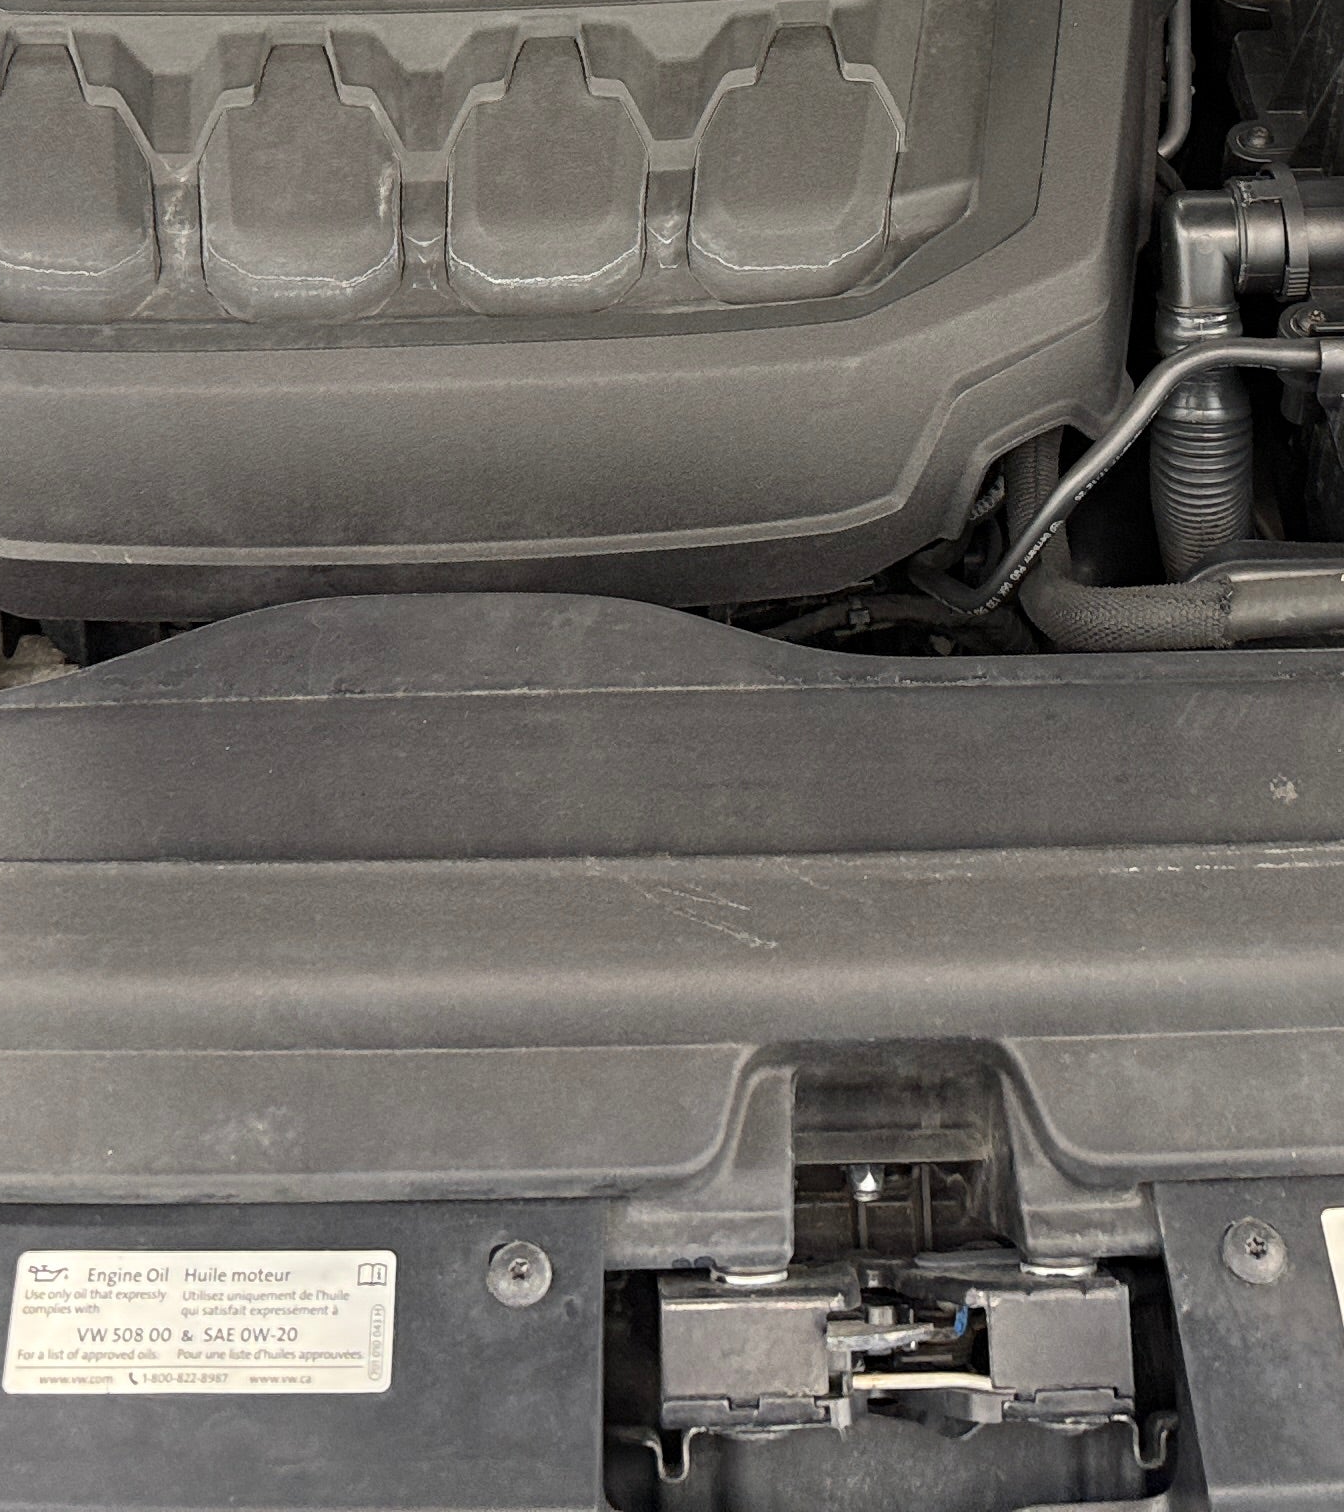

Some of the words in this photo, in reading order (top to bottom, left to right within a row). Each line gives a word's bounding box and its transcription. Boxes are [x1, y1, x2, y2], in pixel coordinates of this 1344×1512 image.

[87, 1267, 142, 1287] Engine
[146, 1267, 169, 1283] Oil
[184, 1267, 228, 1283] Huile
[231, 1267, 291, 1283] moteur
[24, 1289, 46, 1300] Use
[47, 1288, 72, 1303] only
[73, 1288, 88, 1300] oil
[89, 1288, 114, 1300] that
[115, 1289, 167, 1303] expressly
[182, 1290, 224, 1301] Utilisez
[226, 1290, 297, 1304] uniquement
[298, 1289, 314, 1301] de
[22, 1303, 72, 1318] complies
[74, 1303, 101, 1315] with
[180, 1305, 200, 1318] qui
[202, 1304, 247, 1316] satisfait
[76, 1327, 109, 1343] VW
[111, 1326, 144, 1343] 508
[148, 1326, 173, 1343] 00
[181, 1329, 194, 1343] &
[203, 1326, 236, 1343] SAE
[240, 1326, 299, 1343] 0W-20
[17, 1348, 35, 1360] For
[37, 1351, 45, 1360] a
[47, 1348, 65, 1360] list
[66, 1348, 80, 1360] of
[80, 1348, 136, 1362] approved
[176, 1348, 202, 1360] Pour
[205, 1350, 226, 1360] une
[228, 1348, 252, 1360] liste
